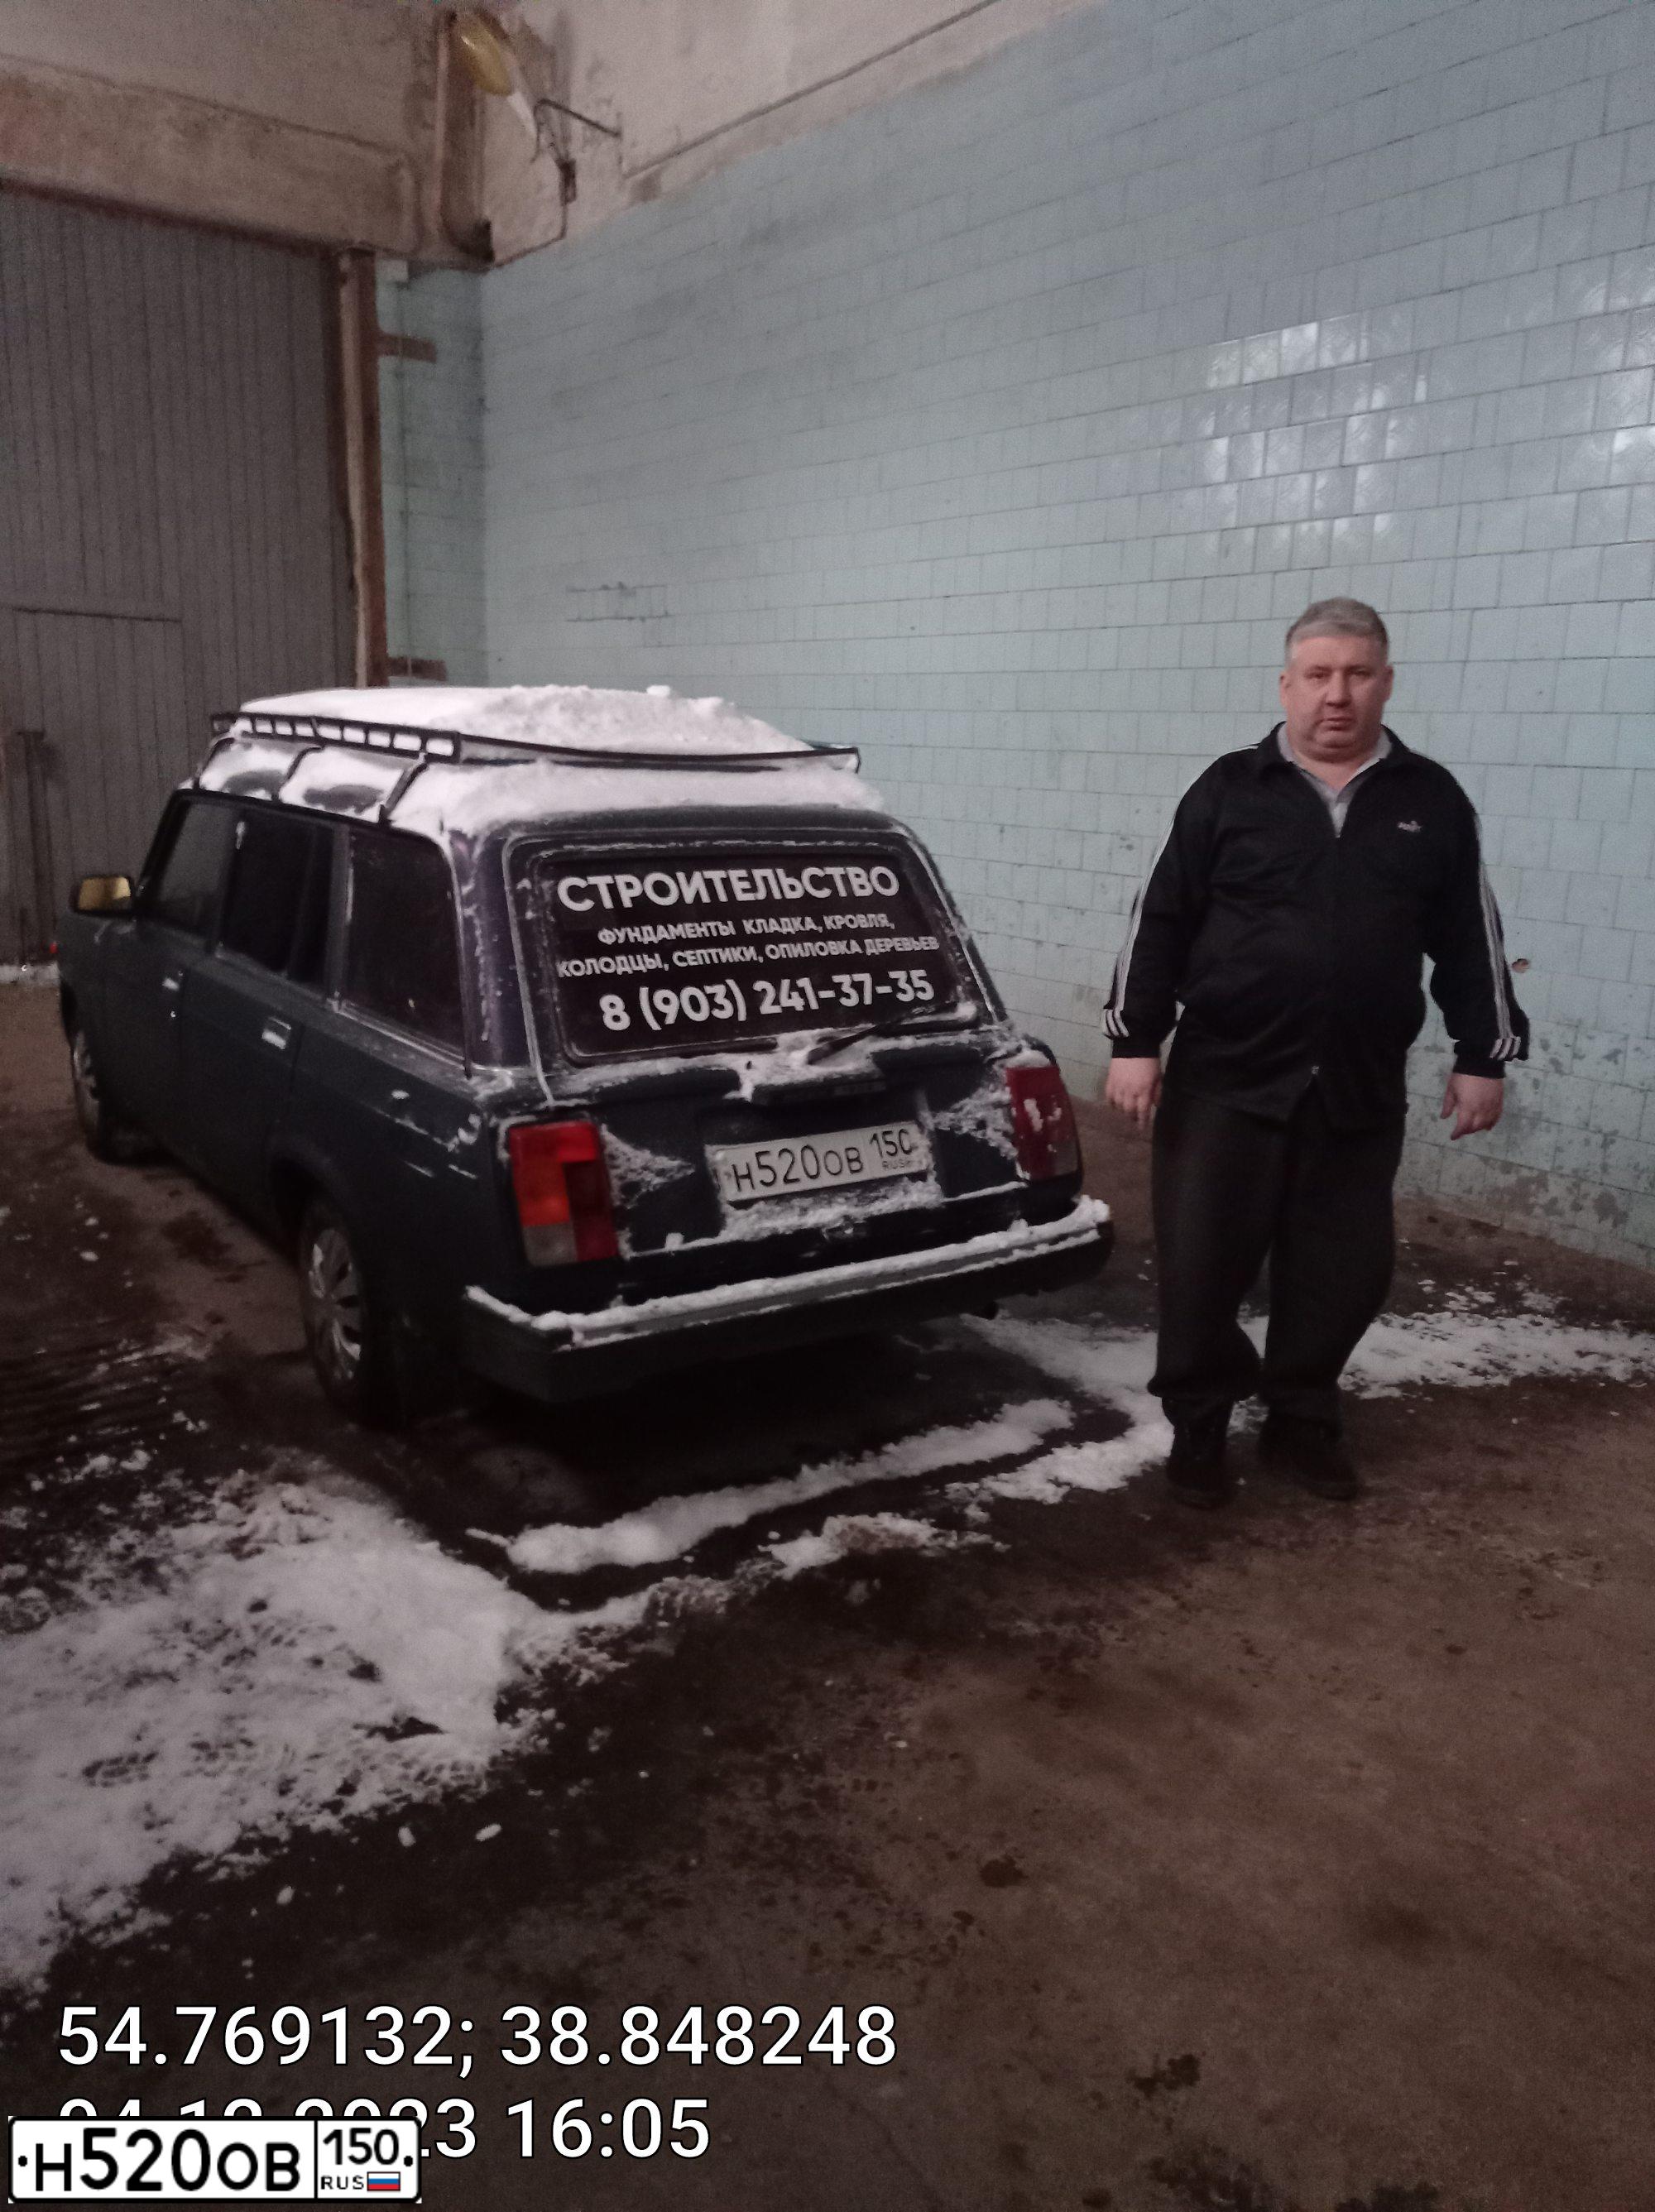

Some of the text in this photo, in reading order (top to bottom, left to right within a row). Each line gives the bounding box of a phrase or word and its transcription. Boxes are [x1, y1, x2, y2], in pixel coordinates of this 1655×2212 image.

[557, 866, 900, 912] СТРОИТЕЛЬСТВО
[597, 913, 895, 945] ФУНДАМЕНТЫ КЛАДКА, КРОВЛЯ,
[556, 936, 940, 978] КОЛОДЦЫ, СЕПТИКИ, ОПИЛОВКА ДЕРЕВЬЕВ
[598, 969, 935, 1031] 8 (903) 241-37-35
